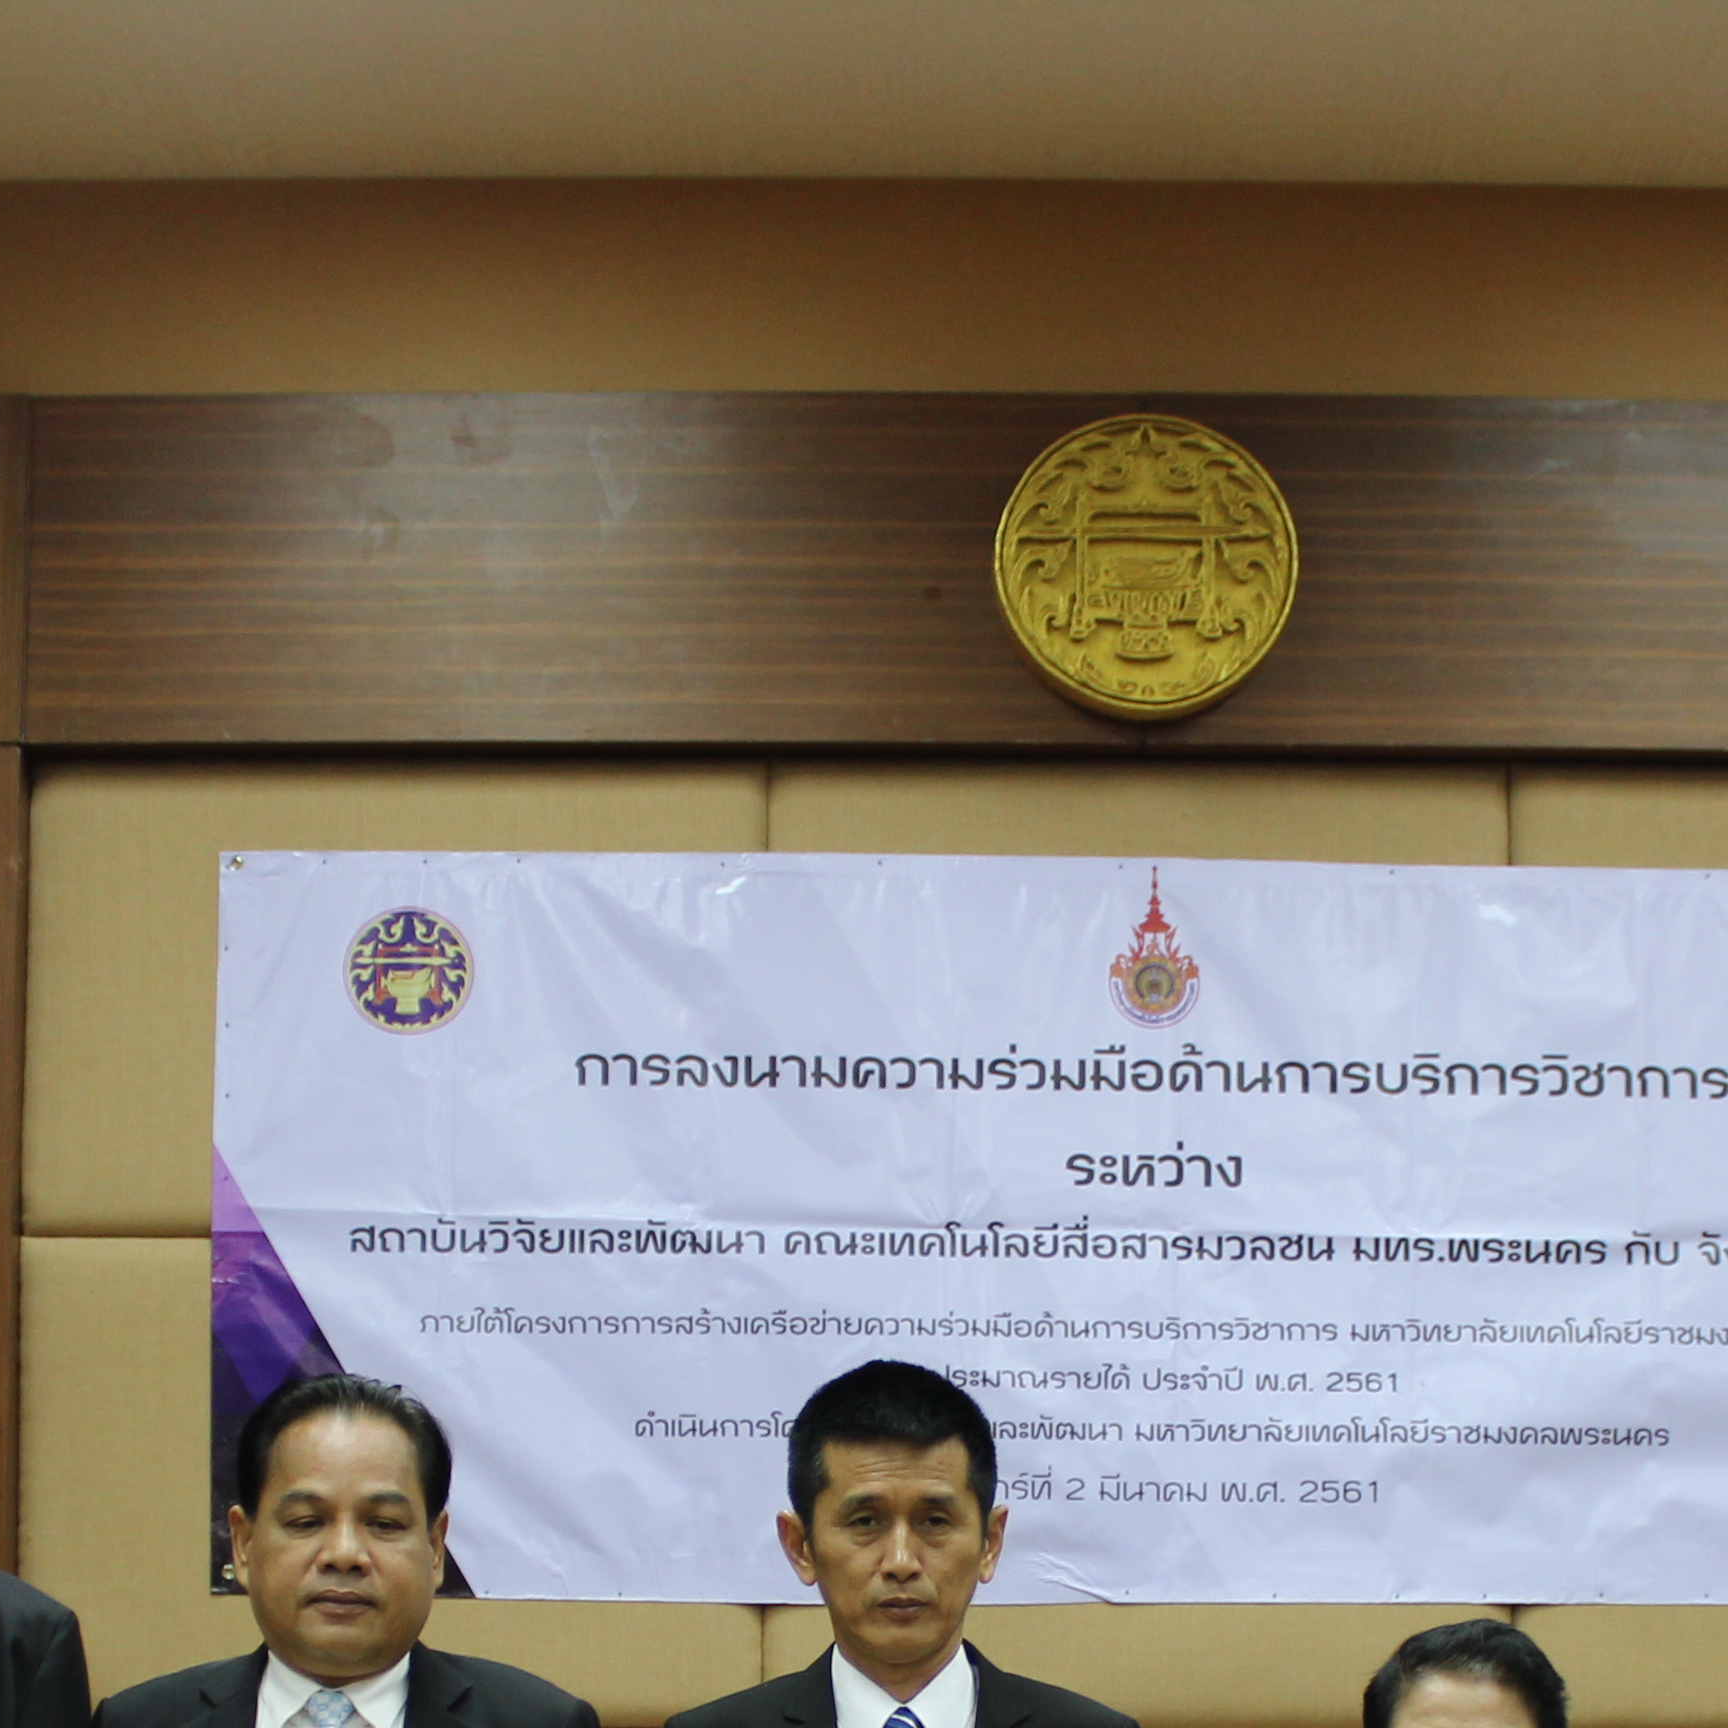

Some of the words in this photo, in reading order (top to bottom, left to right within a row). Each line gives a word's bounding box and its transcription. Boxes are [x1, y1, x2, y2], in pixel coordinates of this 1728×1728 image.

[1064, 1139, 1244, 1190] ระหว่าง
[347, 1216, 767, 1256] สถาบันวิจัยและพัฒนา
[783, 1213, 1337, 1263] คณะเทคโนโลยีสื่อสารมวลชน
[1351, 1234, 1609, 1267] มทร.พระนคร
[1622, 1229, 1681, 1267] กับ
[418, 1305, 1339, 1343] ภายใต้โครงการการสร้างเครือข่ายความร่วมมือด้านการบริการวิชาการ
[1141, 1364, 1245, 1393] ประจำปี
[1254, 1371, 1315, 1393] พ.ศ.
[1324, 1370, 1399, 1394] 2561
[1133, 1414, 1672, 1448] มหาวิทยาลัยเทคโนโลยีราชมงคลพระนคร
[1064, 1476, 1087, 1502] 2
[1097, 1472, 1209, 1504] มีนาคม
[1220, 1479, 1287, 1504] พ.ศ.
[1297, 1478, 1380, 1505] 2561
